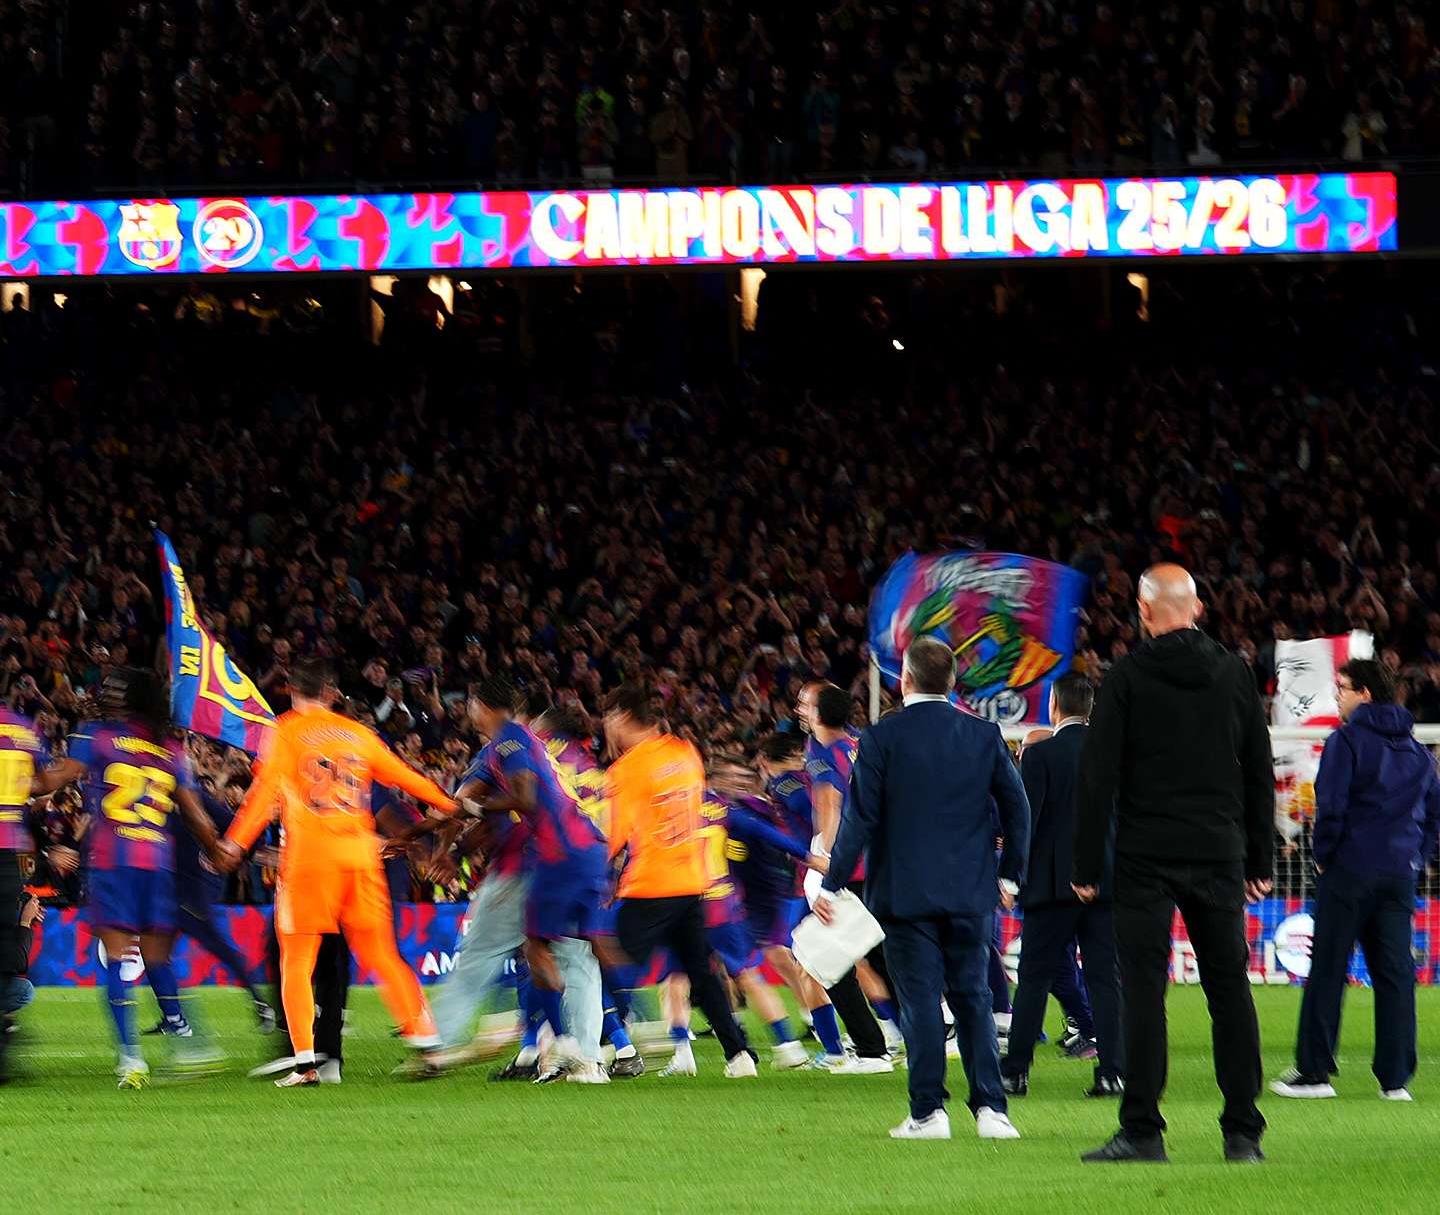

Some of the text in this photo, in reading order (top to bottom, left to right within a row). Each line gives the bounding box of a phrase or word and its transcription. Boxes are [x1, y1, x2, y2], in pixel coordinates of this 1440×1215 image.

[531, 179, 1288, 260] CAMPIONS DE LLIGA 25/26
